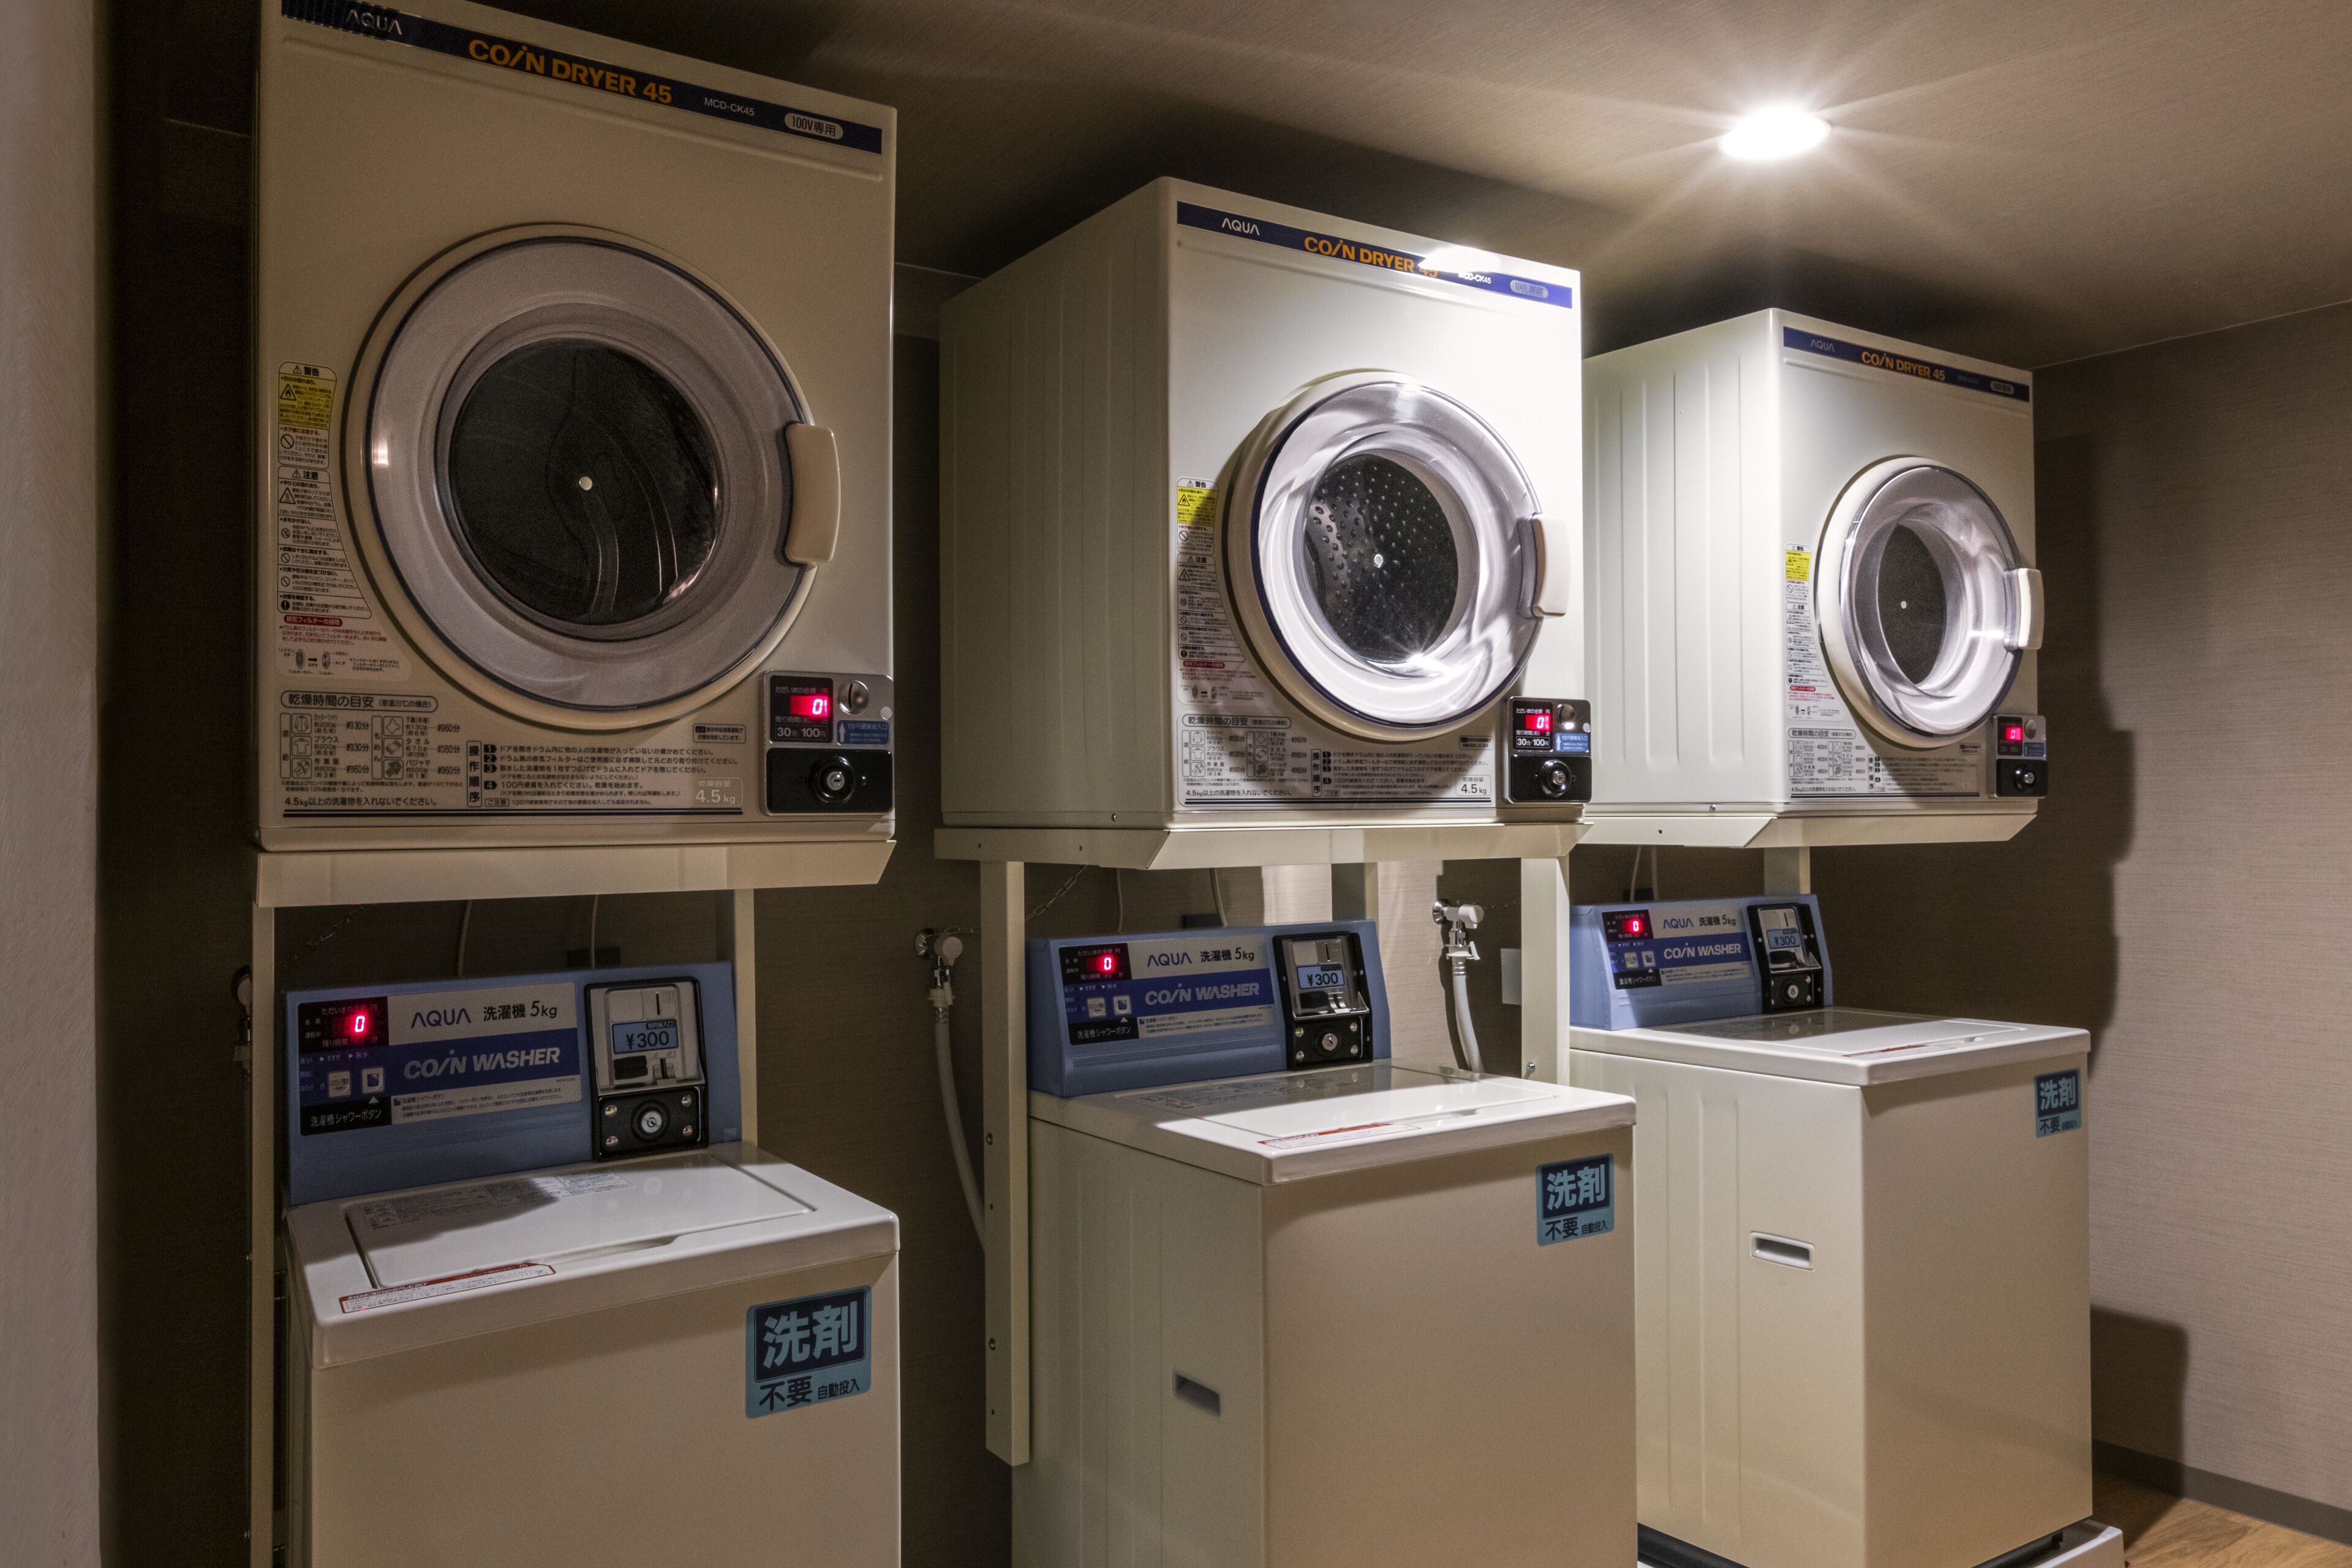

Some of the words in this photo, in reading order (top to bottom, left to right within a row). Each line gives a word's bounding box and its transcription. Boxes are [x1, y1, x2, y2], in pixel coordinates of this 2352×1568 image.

[345, 9, 402, 35] AQUA
[552, 58, 636, 97] DRYER
[643, 81, 672, 105] 45
[704, 97, 755, 117] MCD-CK45
[791, 115, 836, 137] 100V専用
[1221, 217, 1261, 236] AQUA
[1360, 247, 1414, 274] DRYER
[1810, 339, 1835, 353] AQUA
[304, 366, 320, 377] 警告
[1896, 360, 1931, 379] DRYER
[1932, 369, 1946, 382] 45
[303, 470, 318, 480] 注意
[288, 693, 374, 708] 乾燥時間の目安
[346, 722, 369, 730] 約30分
[1188, 716, 1248, 726] 乾燥時間の目安
[2010, 729, 2016, 739] 0
[346, 743, 369, 752] 約30分
[437, 745, 461, 753] 約60分
[346, 765, 369, 774] 約60分
[469, 745, 480, 803] 操作順序
[695, 790, 721, 803] 4.5
[723, 794, 736, 804] kg
[1461, 784, 1477, 794] 4.5
[285, 797, 436, 807] 4.5kg以上の洗濯物を入れないでください。
[1632, 921, 1639, 931] 0
[1663, 918, 1694, 929] AQUA
[1698, 916, 1721, 926] 洗濯機
[1722, 914, 1736, 926] 5kg
[1774, 935, 1796, 946] ¥300
[1147, 952, 1193, 967] AQUA
[1200, 949, 1232, 963] 洗濯機
[1234, 947, 1255, 961] 5kg
[1698, 943, 1741, 957] WASHER
[1104, 957, 1112, 970] 0
[1306, 973, 1339, 987] ¥300
[1196, 982, 1260, 999] WASHER
[411, 1008, 472, 1028] AQUA
[483, 1003, 526, 1022] 洗濯機
[530, 1000, 557, 1019] 5kg
[355, 1015, 366, 1032] 0
[625, 1031, 669, 1049] ¥300
[473, 1047, 560, 1071] WASHER
[2040, 1076, 2076, 1110] 洗剤
[311, 1109, 381, 1127] 洗濯槽シャワーボタン
[2040, 1116, 2060, 1134] 不要
[1547, 1164, 1605, 1210] 洗剤
[1545, 1216, 1578, 1241] 不要
[1581, 1220, 1608, 1235] 自動投入
[763, 1300, 858, 1369] 洗剤
[759, 1375, 812, 1411] 不要
[818, 1378, 860, 1400] 自動投入
